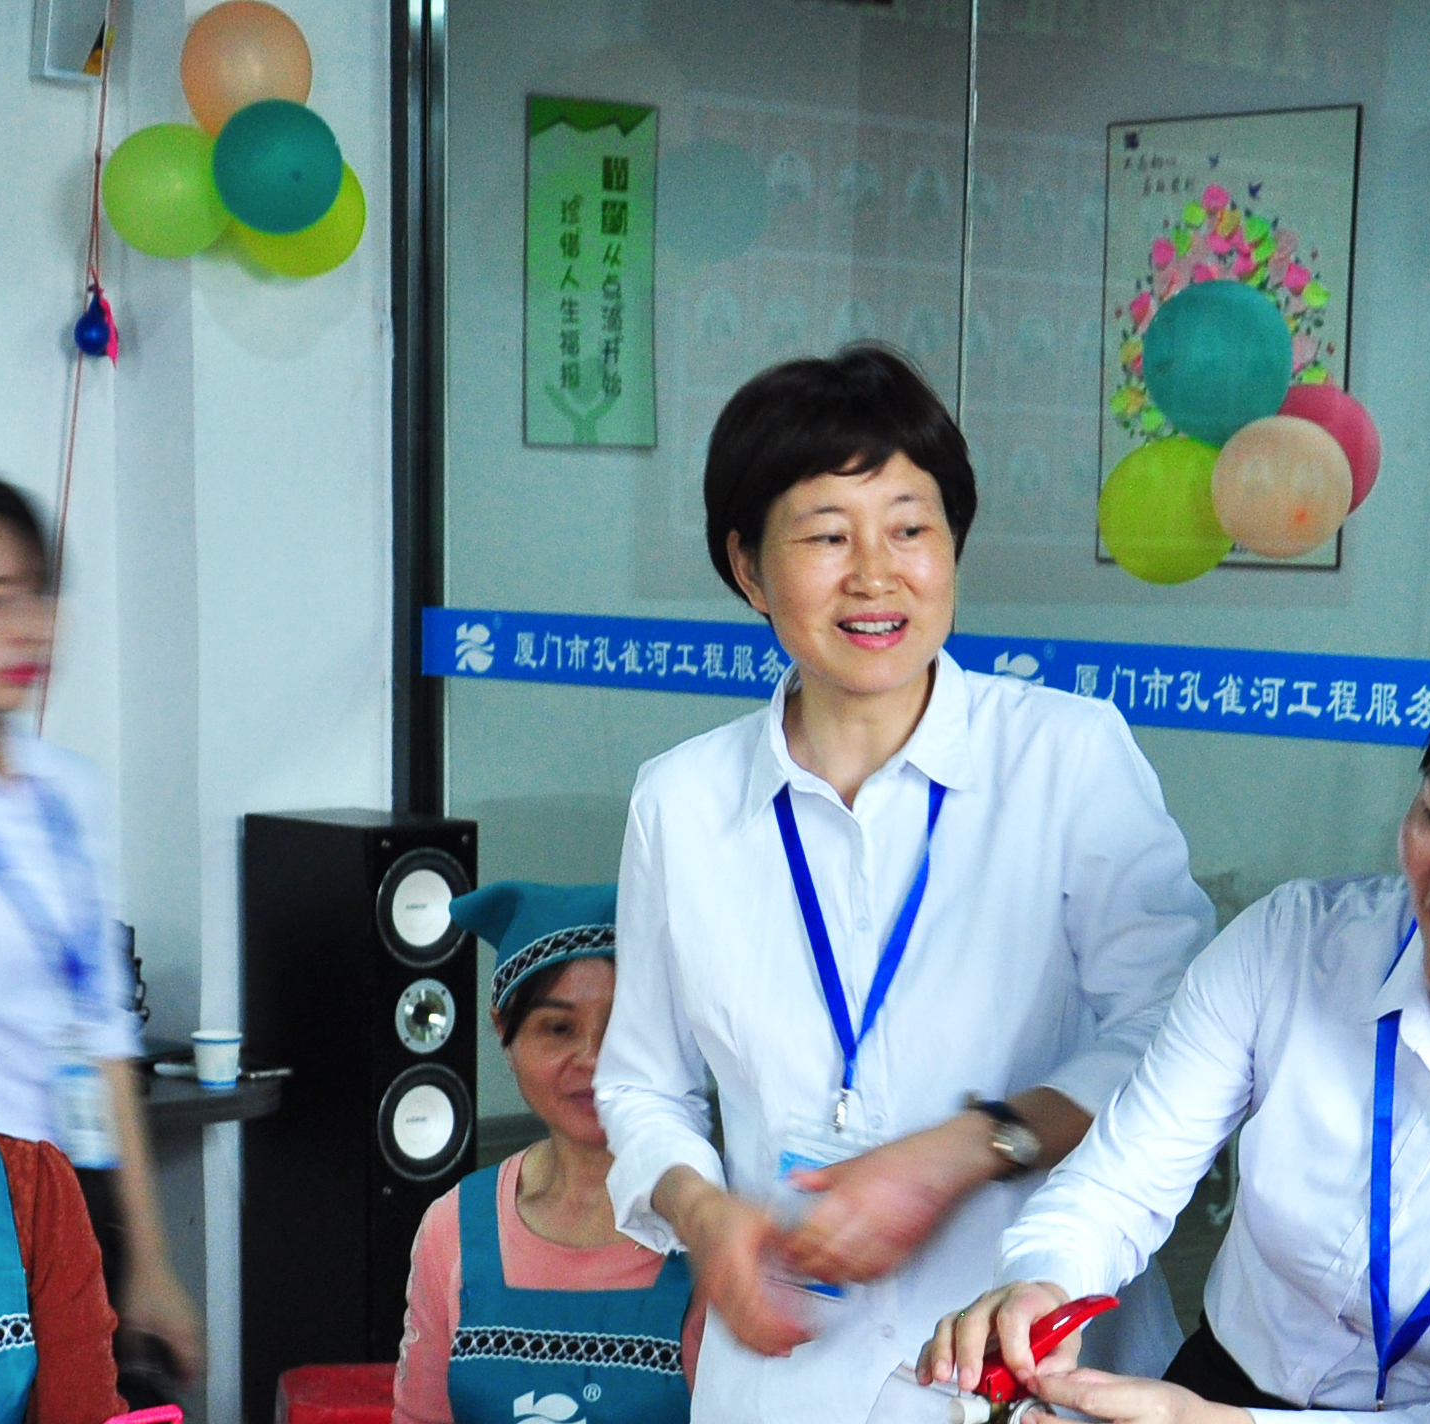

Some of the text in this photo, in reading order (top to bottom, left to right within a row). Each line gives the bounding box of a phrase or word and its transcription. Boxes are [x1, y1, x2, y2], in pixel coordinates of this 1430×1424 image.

[513, 631, 786, 686] 厦门市孔雀河工程服务
